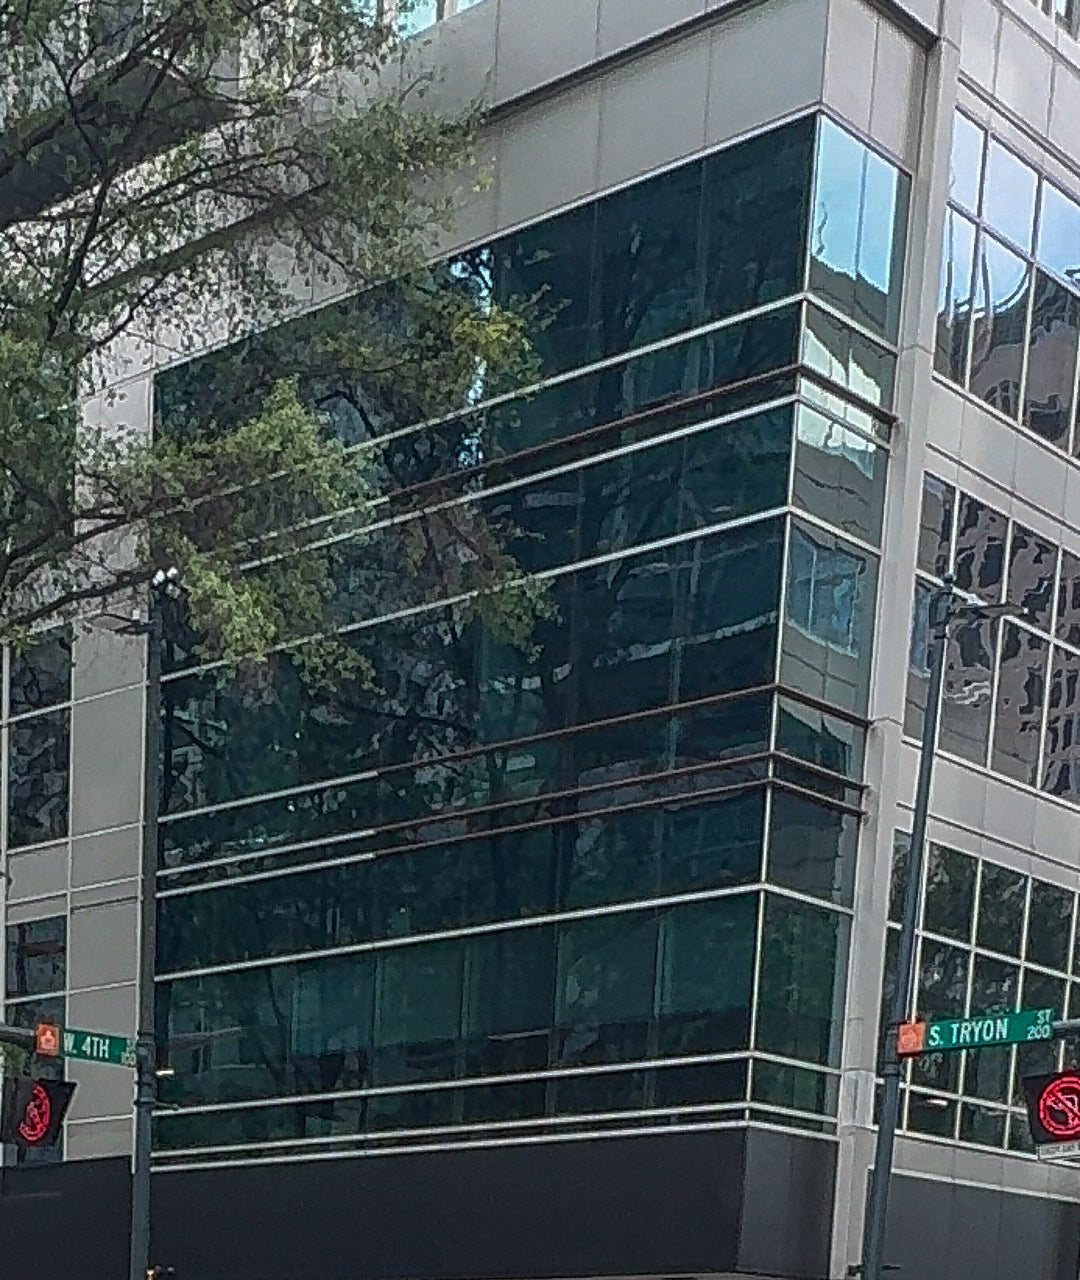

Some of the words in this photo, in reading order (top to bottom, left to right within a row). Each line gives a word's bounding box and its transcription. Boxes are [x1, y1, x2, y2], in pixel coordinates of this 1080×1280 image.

[1036, 1009, 1052, 1025] ST
[928, 1025, 944, 1046] S.
[950, 1017, 1010, 1044] TRYON
[1026, 1024, 1051, 1040] 200
[81, 1035, 110, 1059] 4TH
